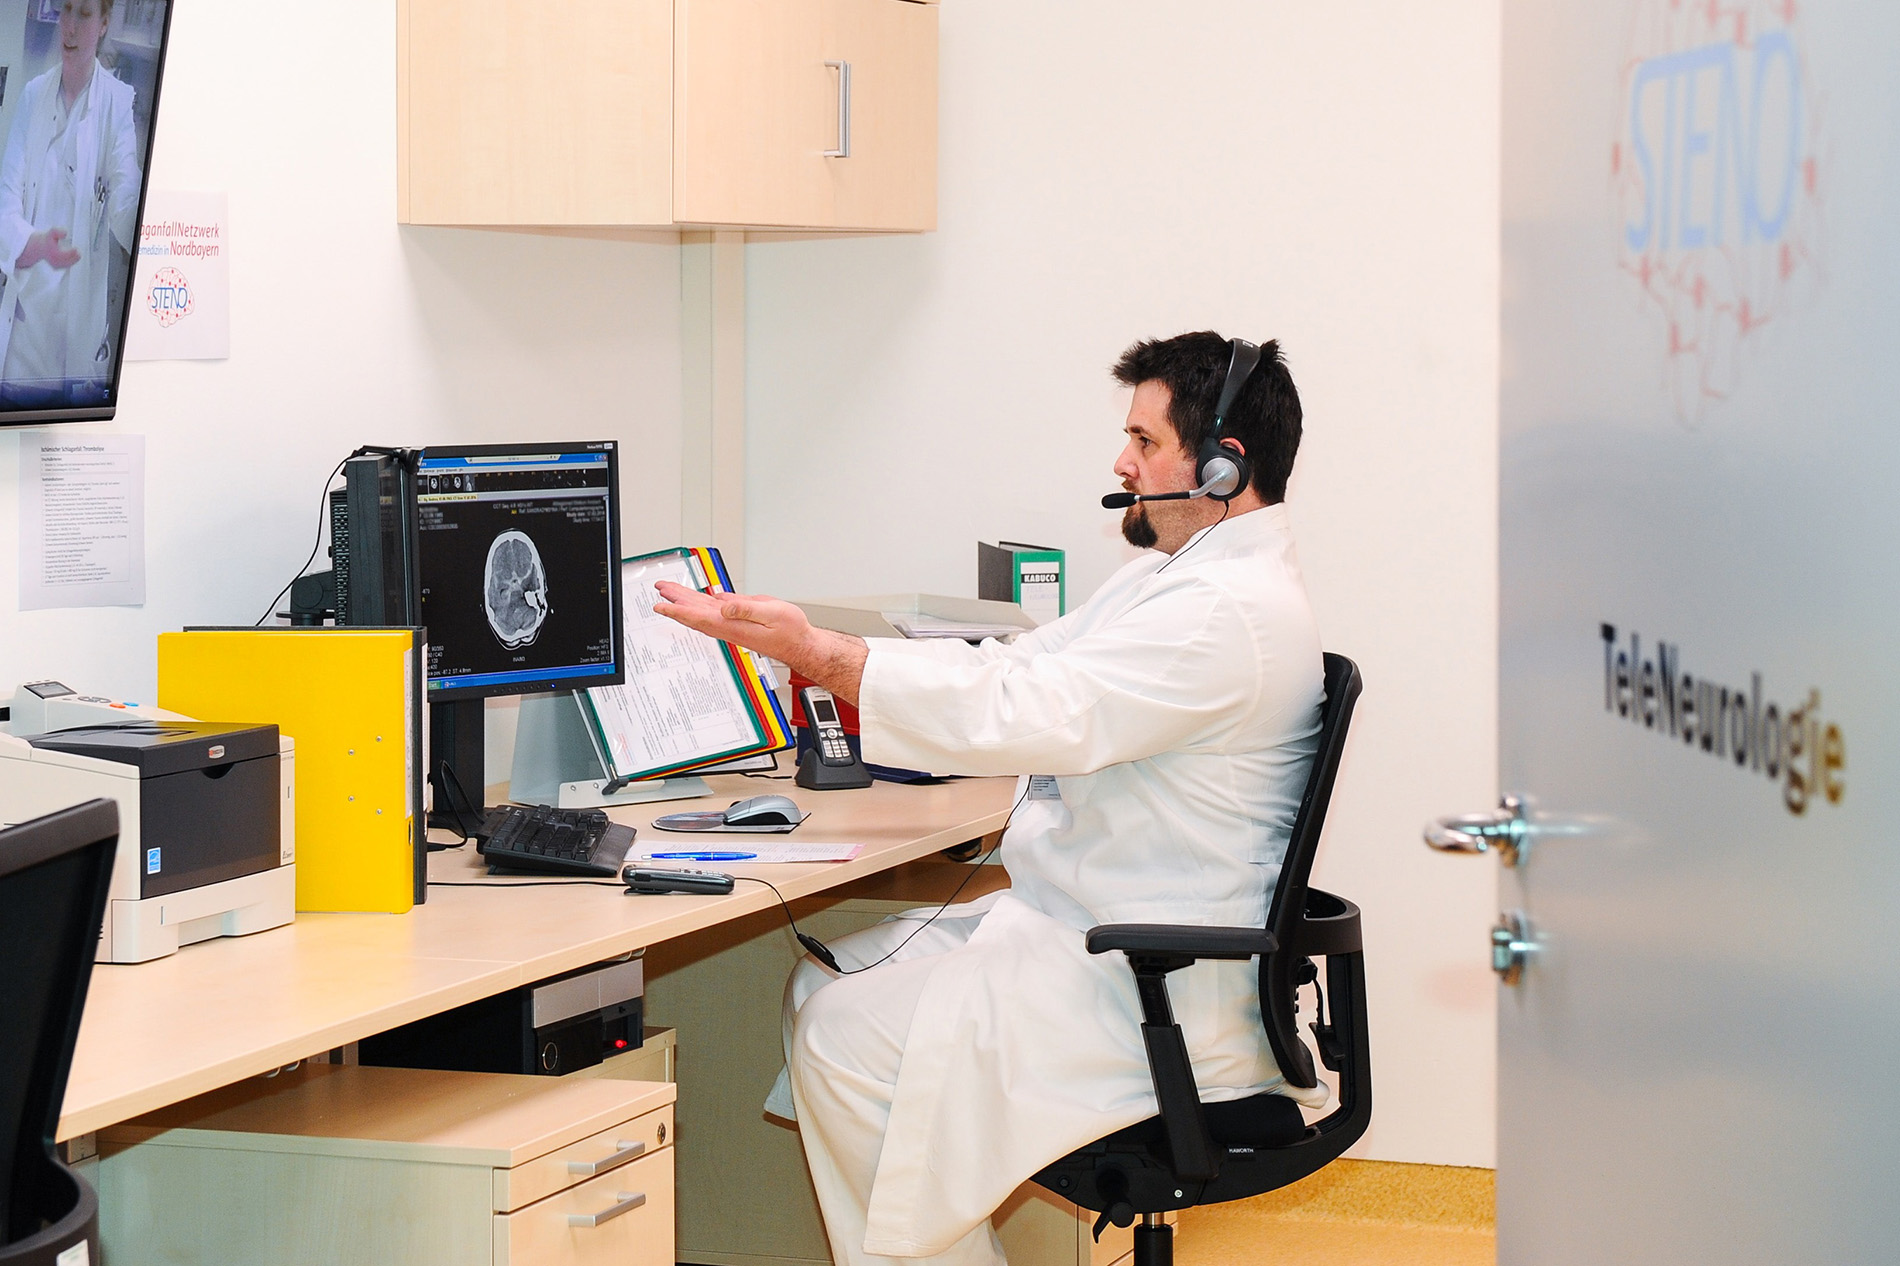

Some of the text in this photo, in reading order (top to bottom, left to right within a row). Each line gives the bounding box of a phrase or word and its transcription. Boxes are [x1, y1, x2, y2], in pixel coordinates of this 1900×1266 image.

[1625, 28, 1805, 253] STENO
[170, 241, 219, 261] Nordbayern
[151, 287, 188, 309] STENO
[1024, 574, 1056, 583] KABUCO
[1599, 622, 1847, 817] TeleNeurologie
